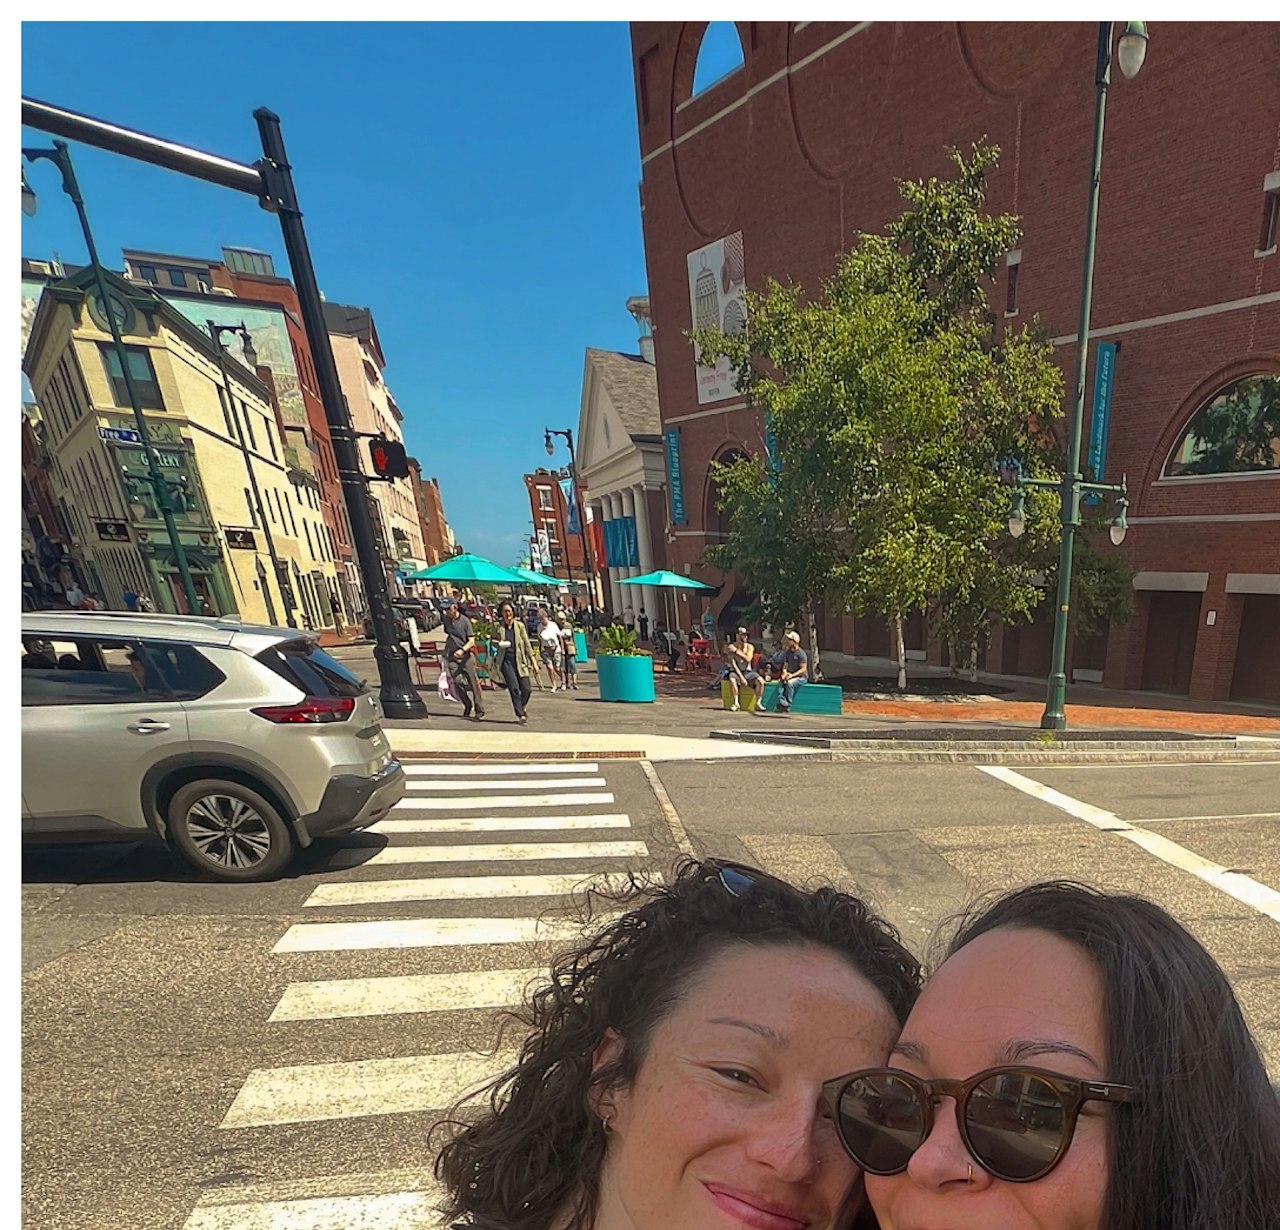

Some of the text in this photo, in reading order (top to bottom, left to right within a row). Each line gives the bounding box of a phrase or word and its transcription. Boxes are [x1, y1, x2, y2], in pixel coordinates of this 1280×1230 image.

[100, 428, 119, 439] Free
[140, 453, 180, 467] GLERY
[669, 433, 683, 519] The PMA Blueprint
